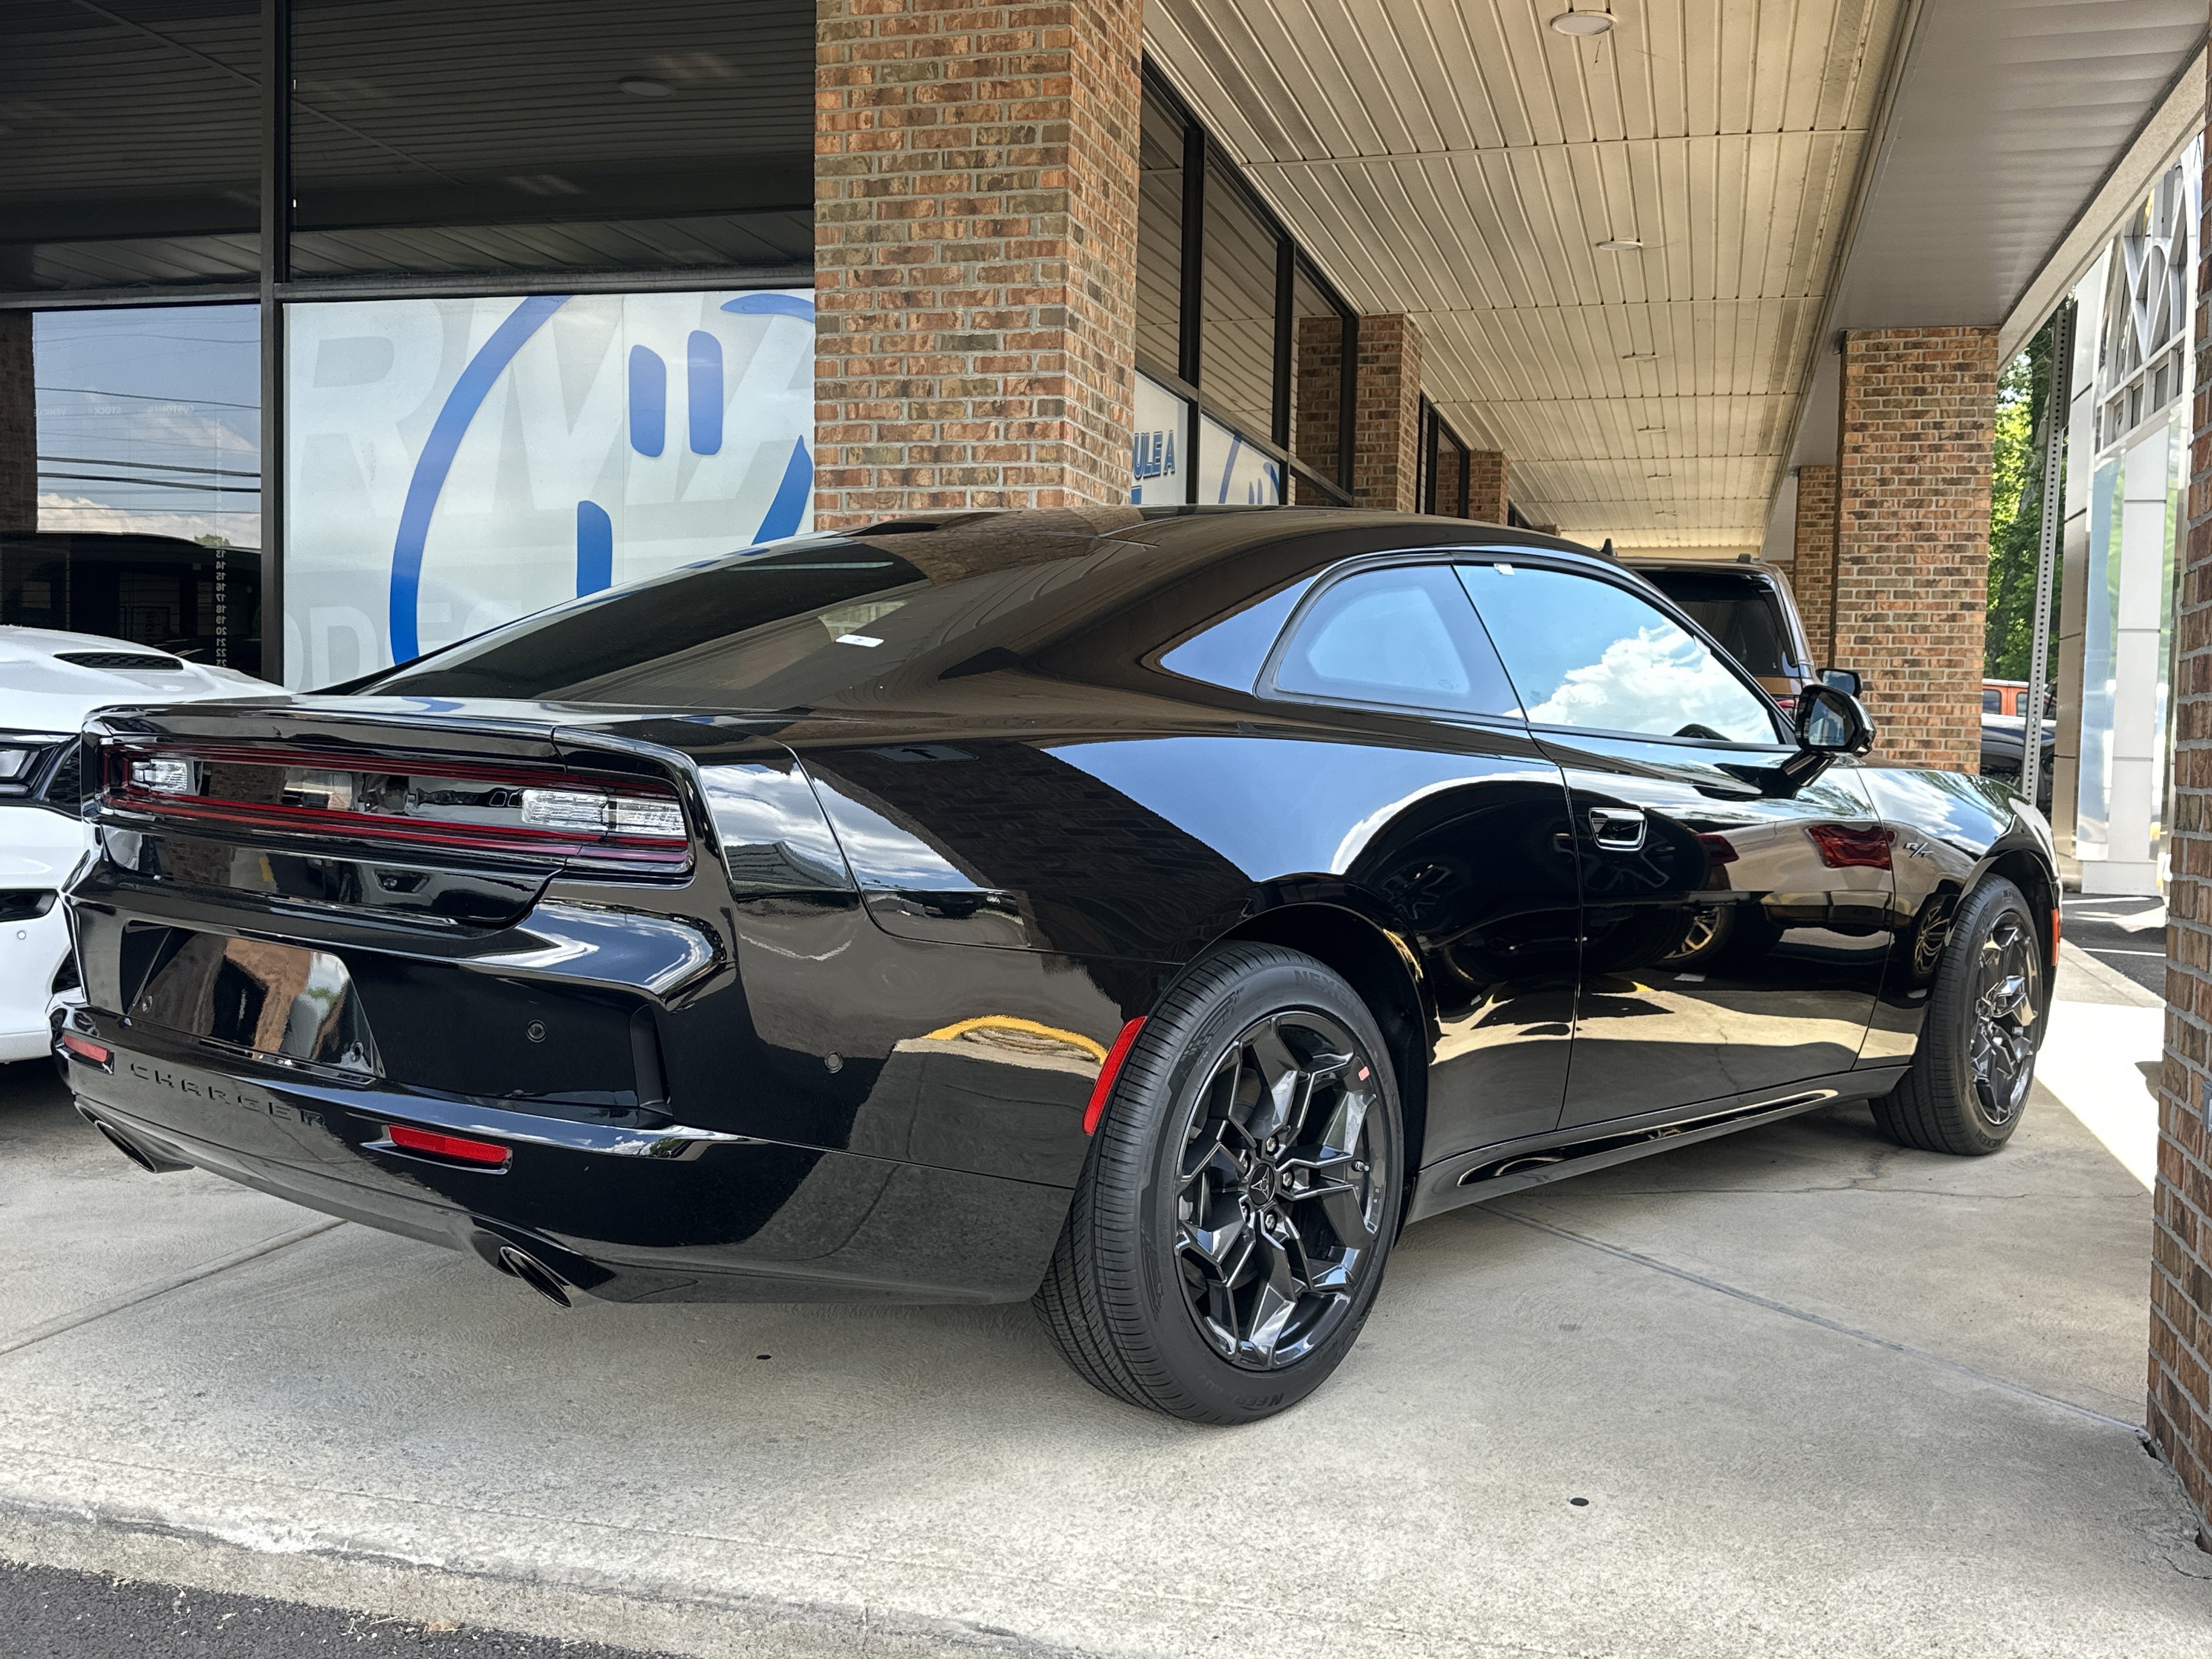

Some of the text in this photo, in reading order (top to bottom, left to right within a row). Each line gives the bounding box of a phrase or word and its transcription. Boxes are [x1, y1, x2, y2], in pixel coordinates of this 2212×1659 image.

[1163, 430, 1175, 476] A
[1903, 842, 1934, 858] R/T
[131, 1062, 326, 1127] CHARGER
